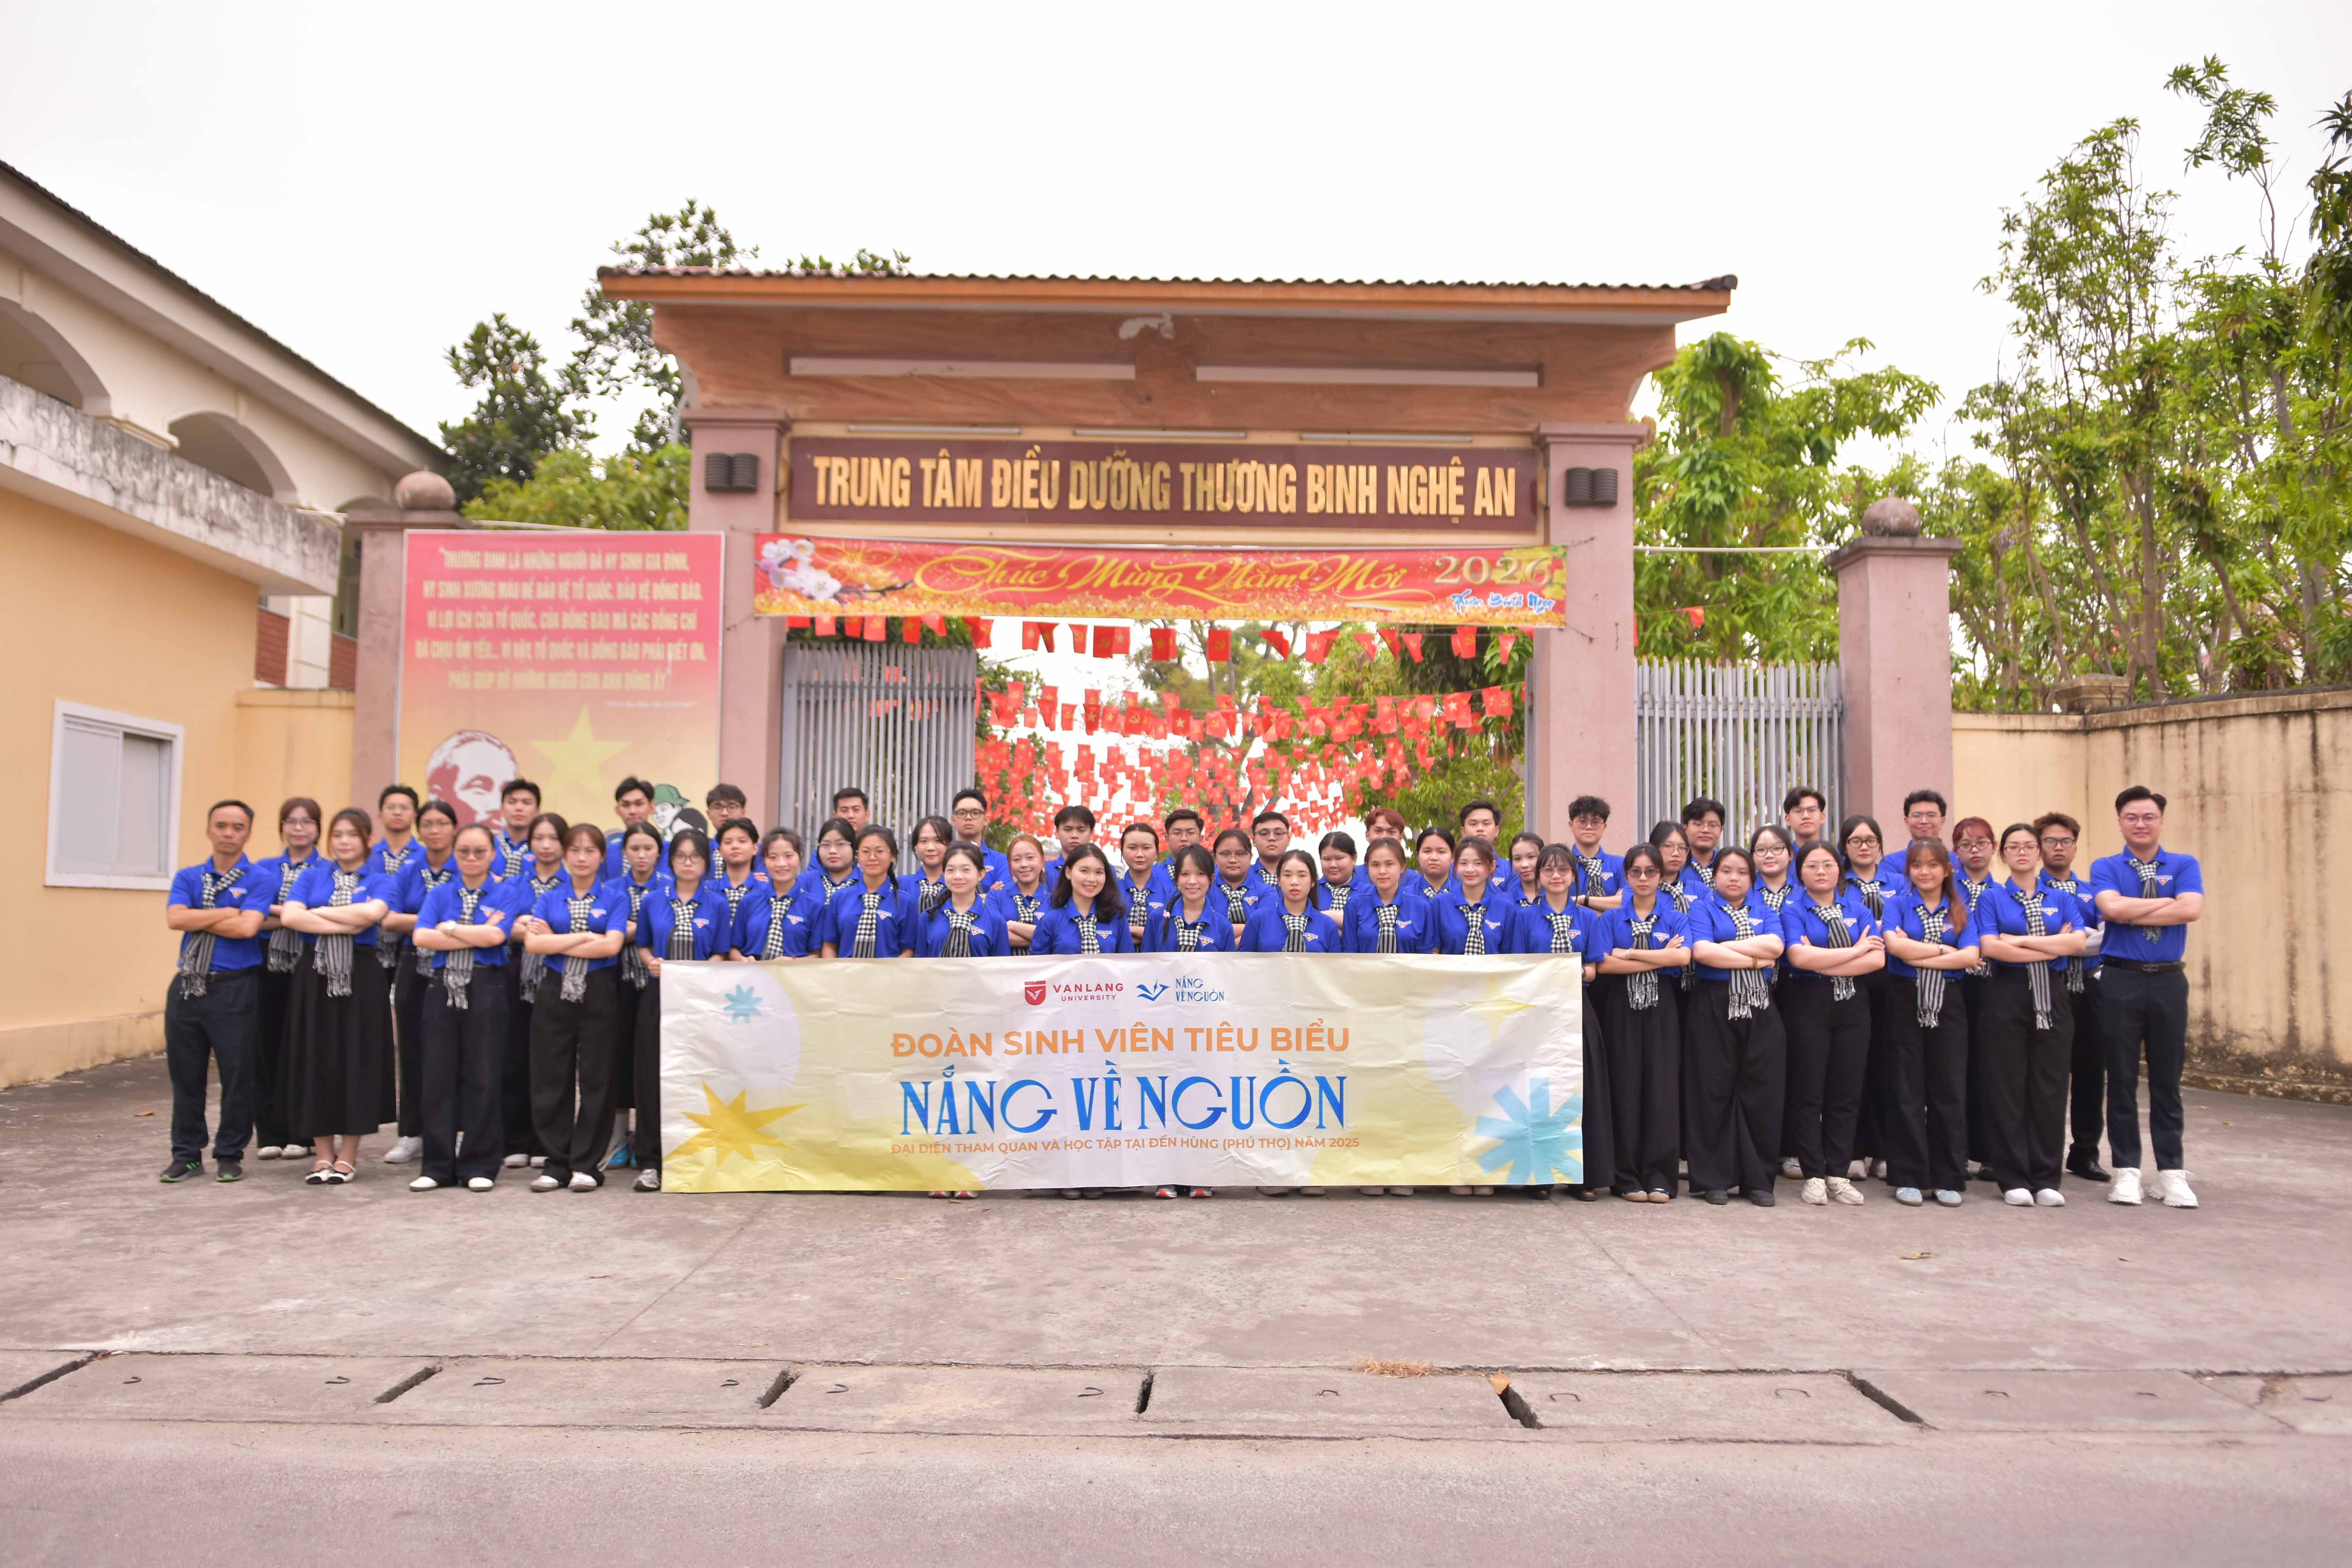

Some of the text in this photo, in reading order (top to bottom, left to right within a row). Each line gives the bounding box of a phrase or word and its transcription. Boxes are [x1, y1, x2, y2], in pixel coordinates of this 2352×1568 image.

[813, 444, 1515, 524] TRUNG TÂM ĐIỀU DƯỠNG THƯƠNG BINH NGHỆ AN
[914, 546, 1409, 601] Chúc Mừng Năm Mới
[1434, 555, 1553, 586] 2026
[1176, 976, 1204, 988] NẮNG
[1176, 989, 1224, 1001] VỀ NGUỒN
[891, 1018, 1349, 1057] ĐOÀN SINH VIÊN TIÊU BIỂU
[900, 1058, 1348, 1135] NẮNG VỀ NGUỒN
[891, 1134, 1359, 1156] ĐẠI DIỆN THAM QUAN VÀ HỌC TẬP TẠI ĐỀN HÙNG (PHÚ THỌ) NĂM 2025
